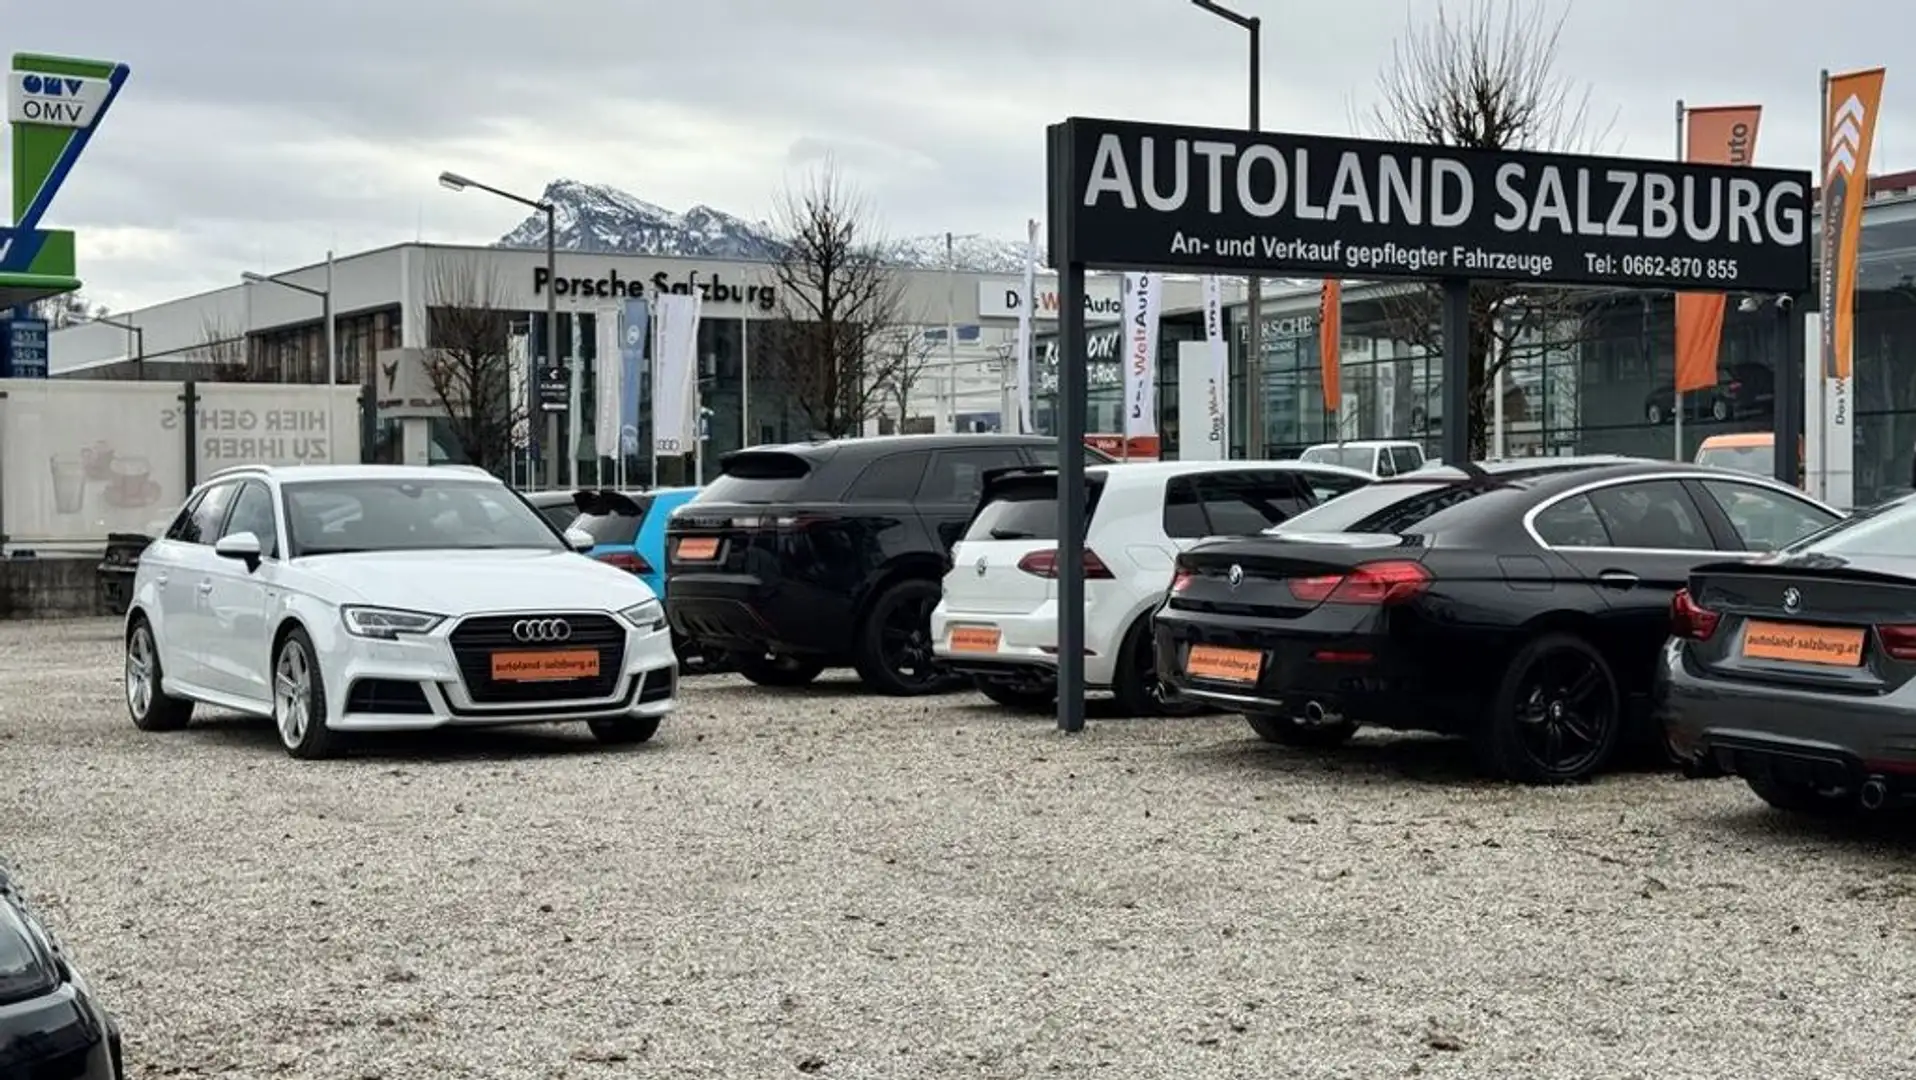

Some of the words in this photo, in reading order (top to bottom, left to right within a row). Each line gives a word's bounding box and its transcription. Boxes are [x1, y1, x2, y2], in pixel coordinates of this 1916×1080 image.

[24, 101, 82, 122] OMV
[1728, 123, 1748, 164] uto
[1083, 133, 1473, 227] AUTOLAND
[1494, 163, 1804, 246] SALZBURG
[1170, 231, 1210, 254] An-
[1216, 236, 1255, 258] und
[1262, 236, 1341, 260] Verkauf
[1345, 242, 1448, 268] gepflegter
[1452, 246, 1553, 275] Fahrzeuge
[1585, 253, 1617, 274] Tel:
[1622, 254, 1701, 277] 0662-870
[1706, 257, 1738, 279] 855
[534, 267, 644, 299] Porsche
[652, 270, 775, 310] Salzburg
[1241, 315, 1313, 341] PRSCHE
[1747, 634, 1860, 654] autoland-salzburg.at
